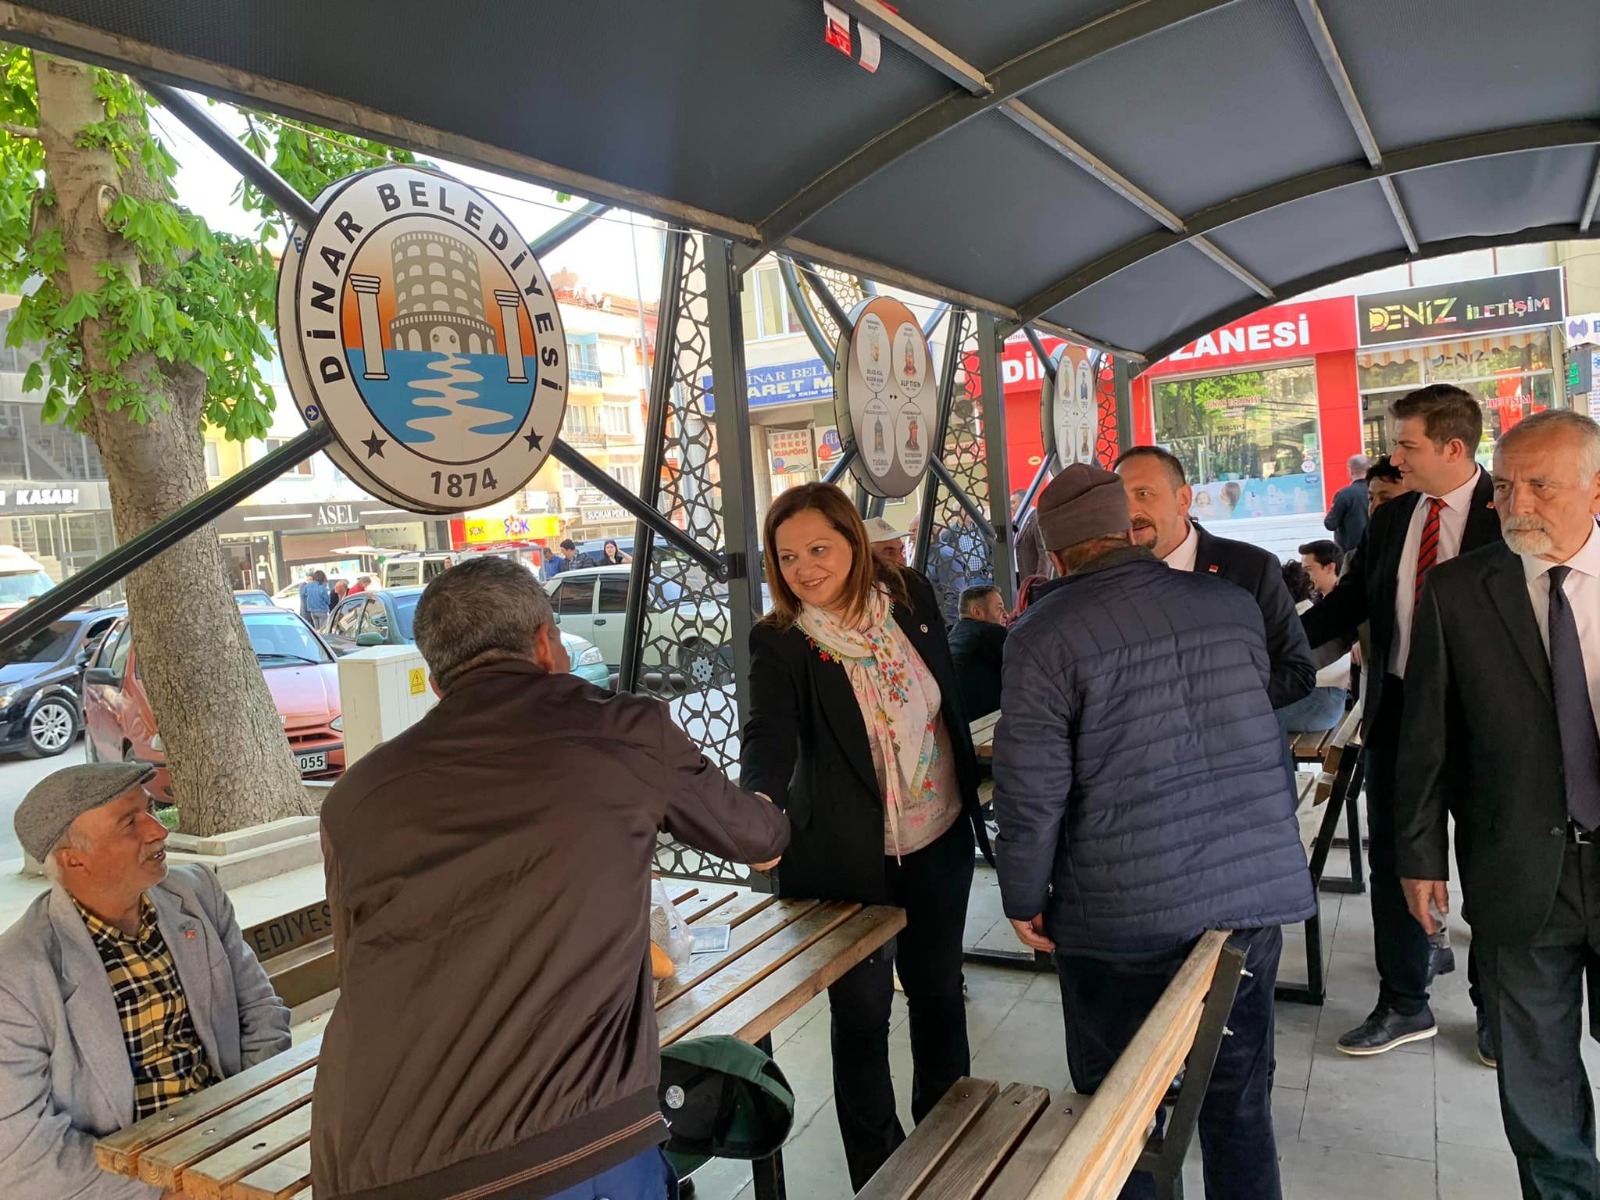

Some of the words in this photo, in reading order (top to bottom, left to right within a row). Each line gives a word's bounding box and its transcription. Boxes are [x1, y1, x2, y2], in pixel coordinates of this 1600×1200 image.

[307, 210, 364, 384] DİNAR
[376, 179, 563, 392] BELEDİYESİ
[1369, 297, 1457, 332] DENİZ
[747, 369, 786, 385] İNAR
[747, 380, 804, 398] ARET
[430, 467, 498, 498] 1874
[16, 488, 79, 505] KASABI
[317, 504, 359, 526] ASEL
[301, 756, 323, 769] 055
[253, 904, 332, 954] EDIYES
